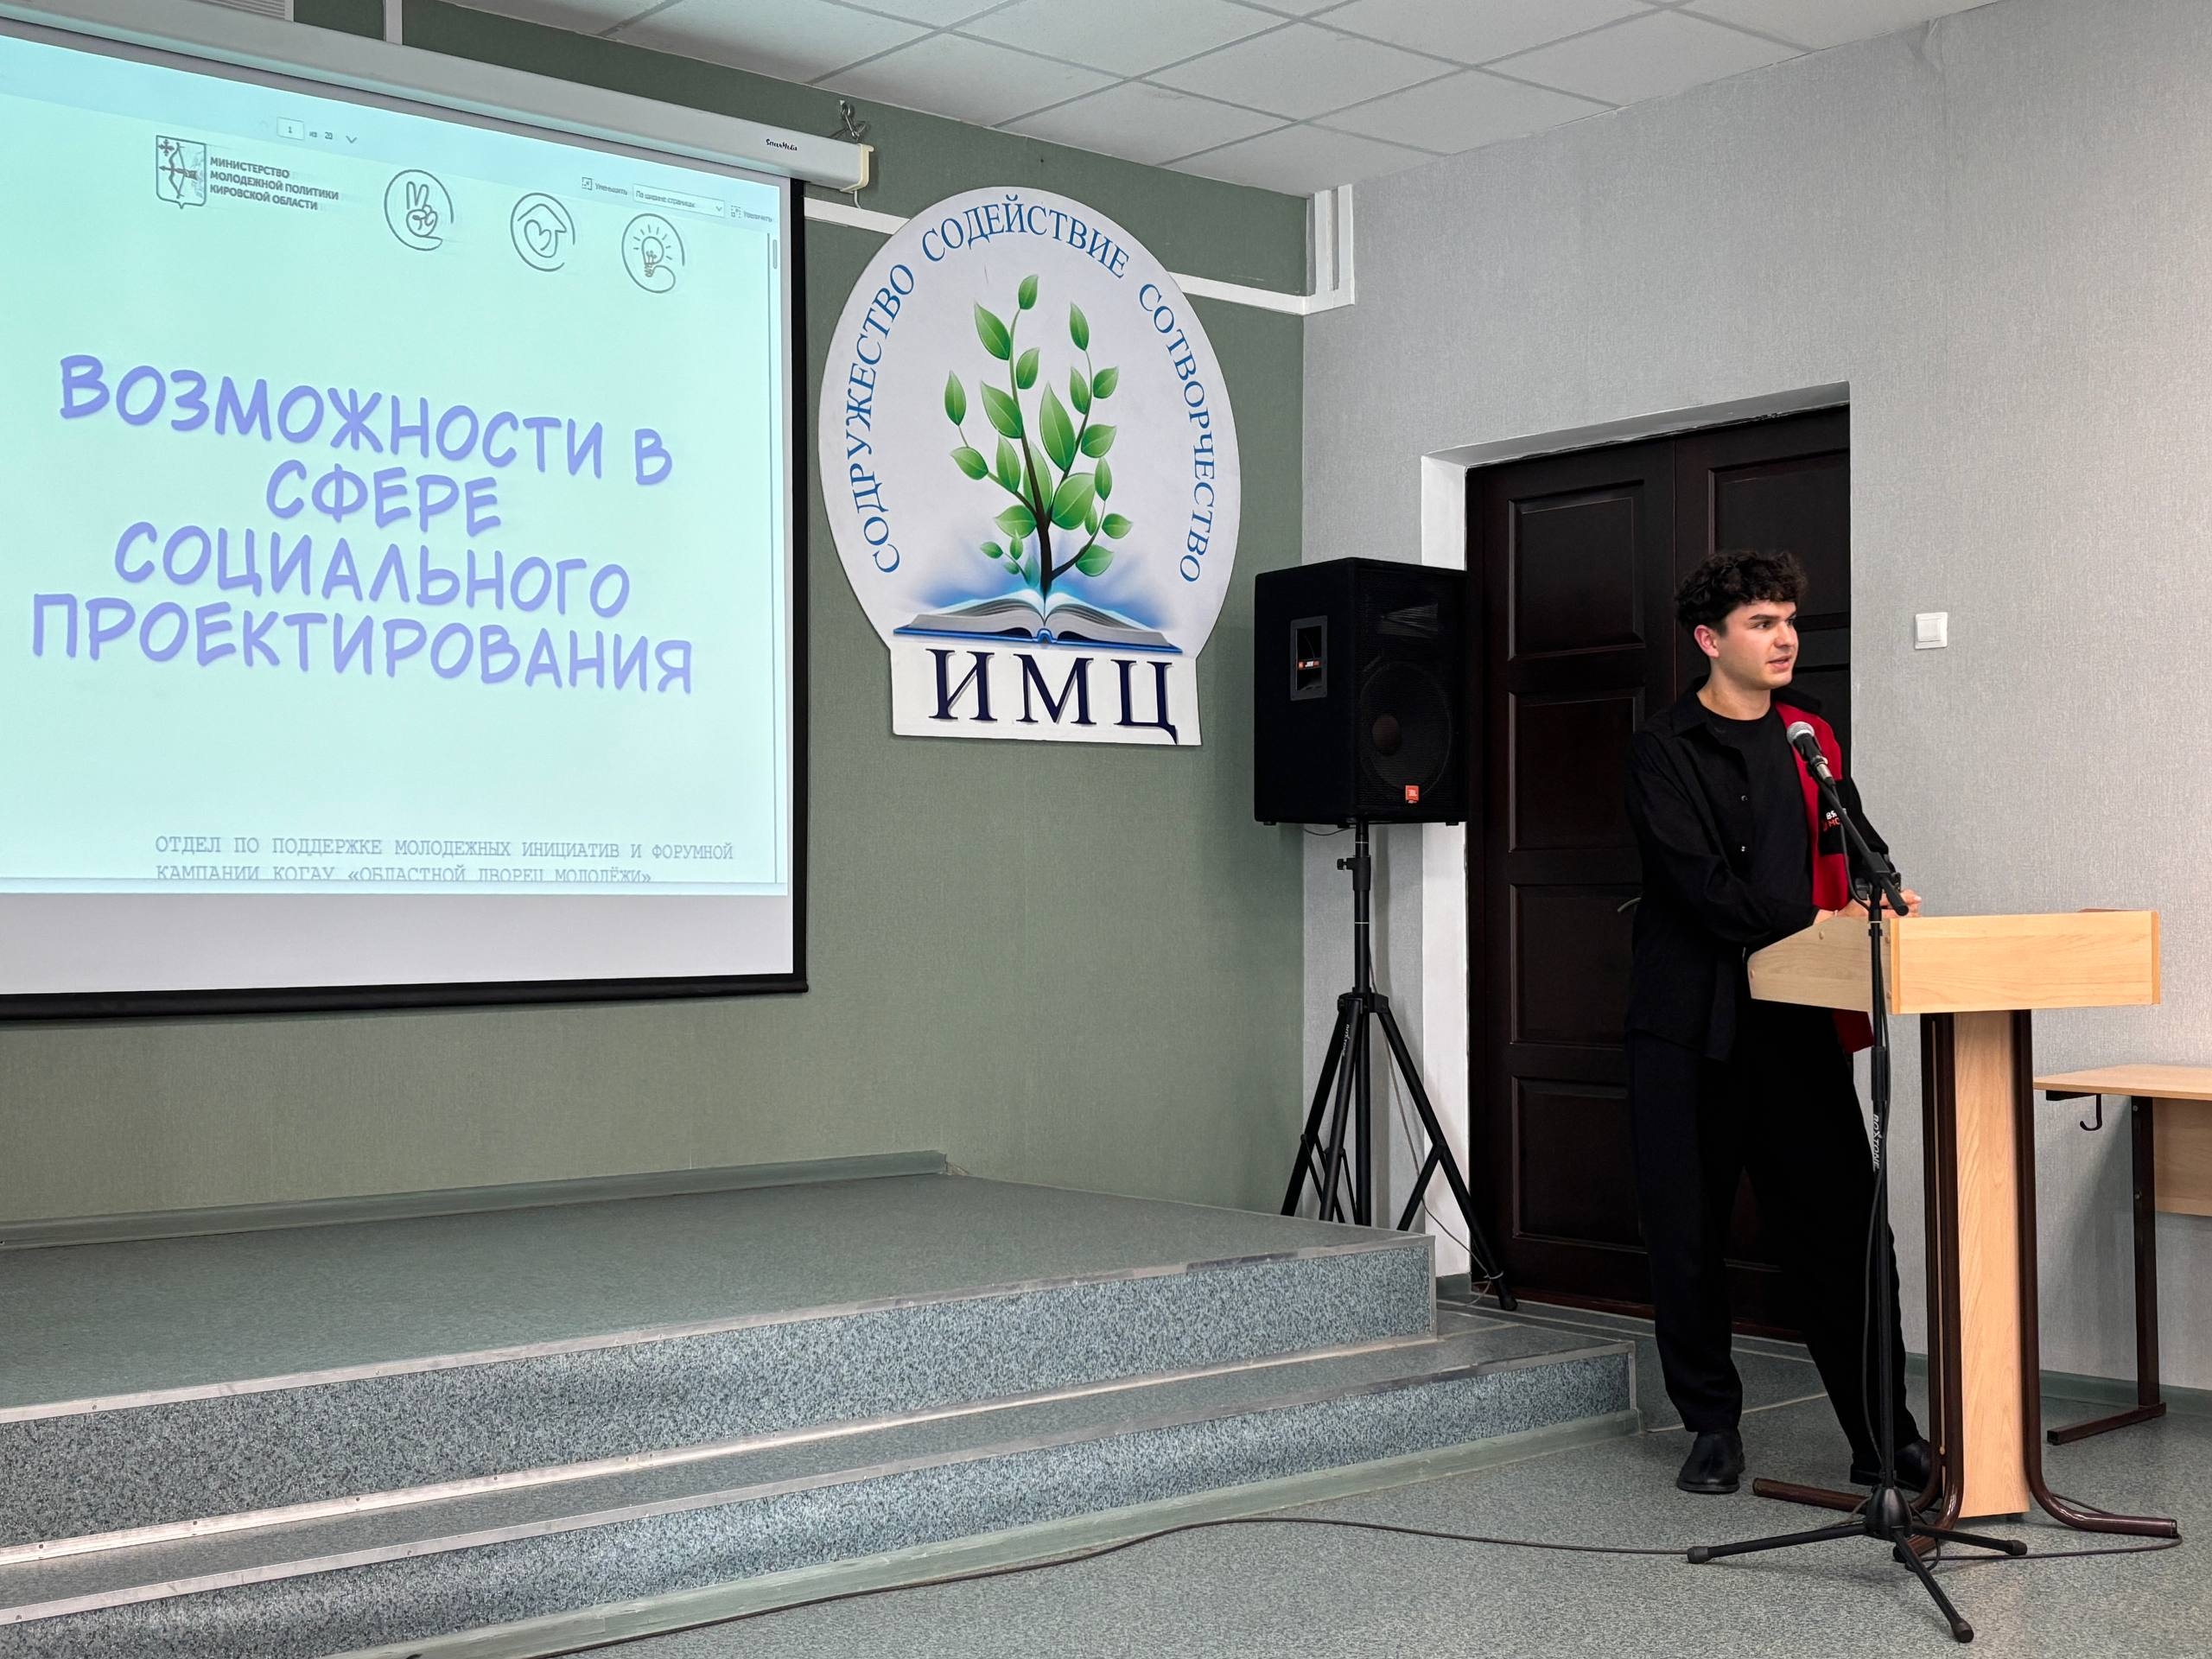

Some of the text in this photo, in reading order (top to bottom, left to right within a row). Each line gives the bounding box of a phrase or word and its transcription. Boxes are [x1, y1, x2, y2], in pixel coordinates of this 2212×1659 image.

[210, 156, 290, 179] МИНИСТЕРСТВО
[210, 170, 340, 200] МОЛОДЕЖНОЙ ПОЛИТИКИ
[210, 184, 319, 211] КИРОВСКОЙ ОБЛАСТИ
[60, 353, 674, 486] ВОЗМОЖНОСТИ В
[846, 194, 1216, 582] СОДРУЖЕСТВО СОДЕЙСТВИЕ СОТВОРЧЕСТВО
[265, 460, 502, 537] СФЕРЕ
[114, 521, 630, 618] СОЦИАЛЬНОГО
[32, 593, 693, 694] ПРОЕКТИРОВАНИЯ
[925, 648, 1178, 745] ИМЦ
[155, 836, 734, 861] ОТДЕЛ ПО ПОДДЕРЖКЕ МОЛОДЕЖНЫХ ИНИЦИАТИВ И ФОРУМНОЙ
[156, 865, 261, 880] КАМПАНИИ
[272, 866, 336, 880] КОГАУ
